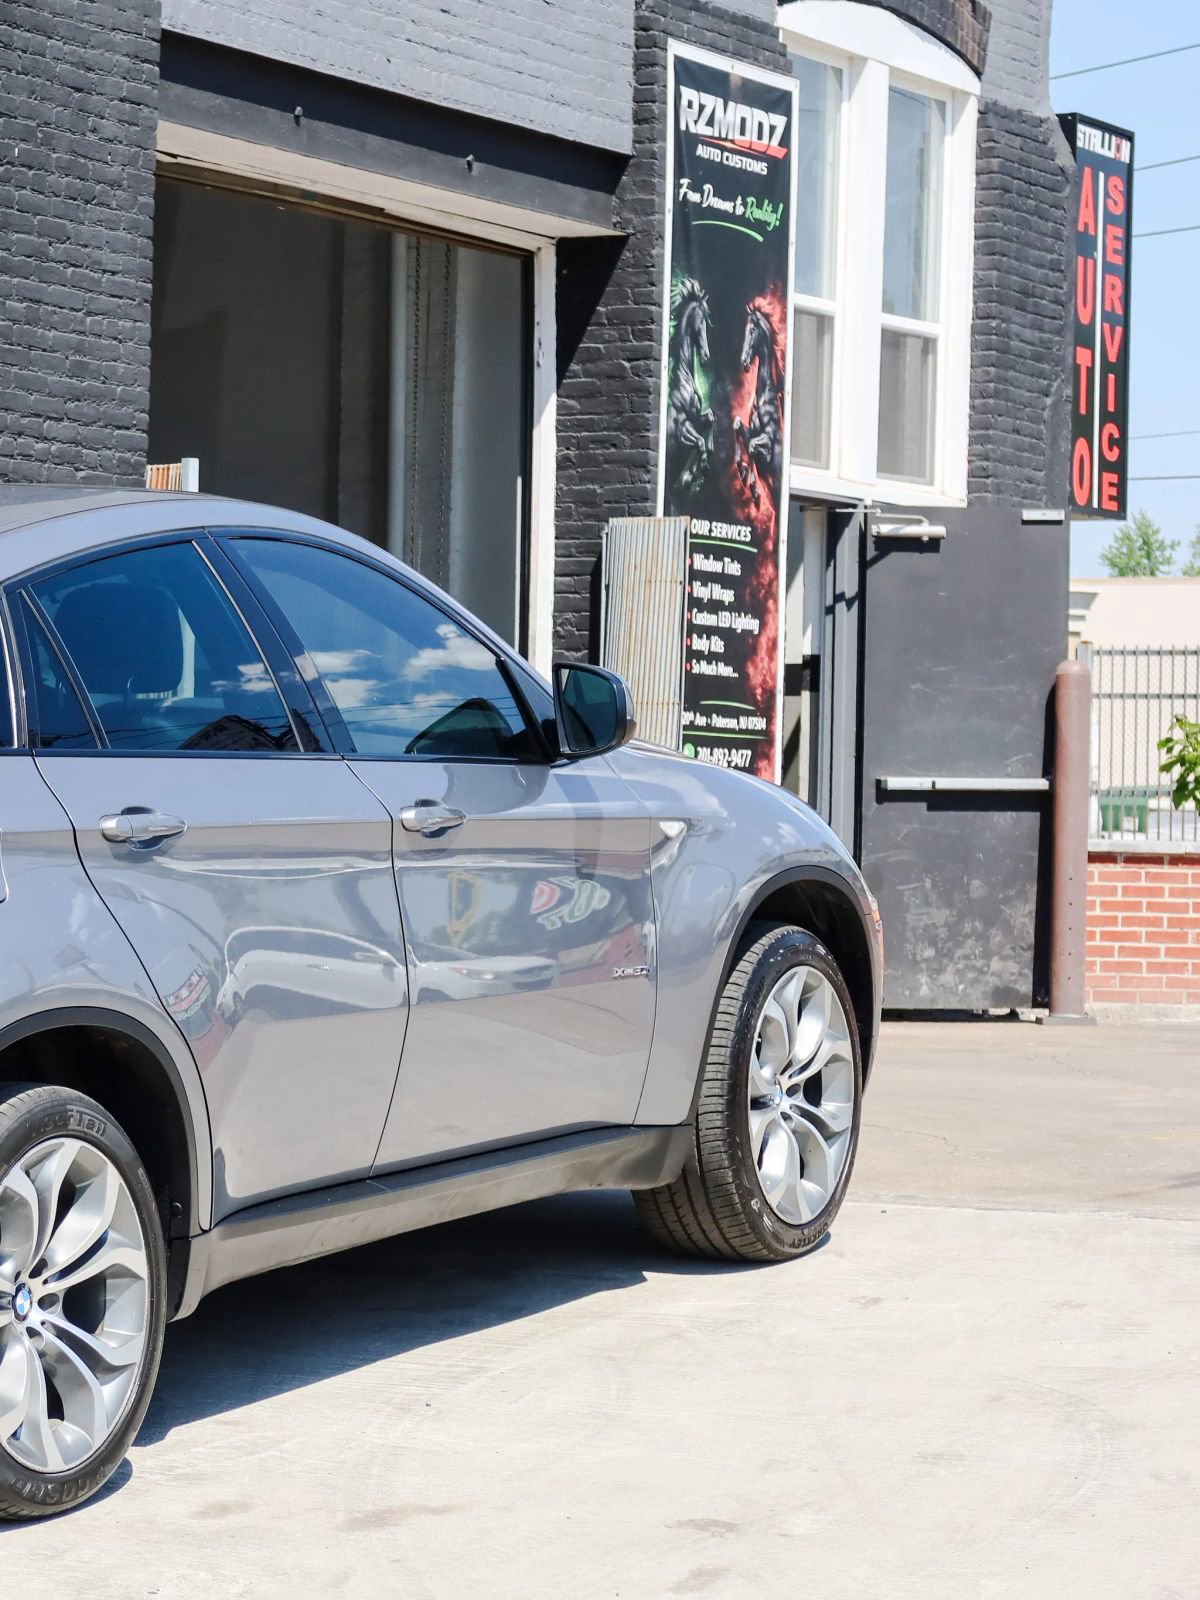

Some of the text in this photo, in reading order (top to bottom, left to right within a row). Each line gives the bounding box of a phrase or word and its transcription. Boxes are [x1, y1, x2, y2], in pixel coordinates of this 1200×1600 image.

[680, 85, 788, 159] RZMODZ
[1076, 123, 1131, 164] STALLION
[696, 144, 768, 175] AUTO CUSTOMS
[679, 178, 784, 231] From Dreams to Reality!
[1072, 165, 1096, 507] AUTO
[1101, 174, 1126, 512] SERVICE
[691, 518, 752, 542] OUR SERVICES
[693, 552, 741, 576] Window Tints
[692, 581, 735, 606] Vinyl Wraps
[692, 608, 760, 635] Custom LED Lighting
[692, 633, 725, 655] Body Kits
[691, 659, 739, 677] So Much More...
[695, 712, 707, 727] Ave
[711, 713, 738, 731] Paterson,
[739, 715, 748, 730] NJ
[697, 746, 752, 768] 201-892-9477
